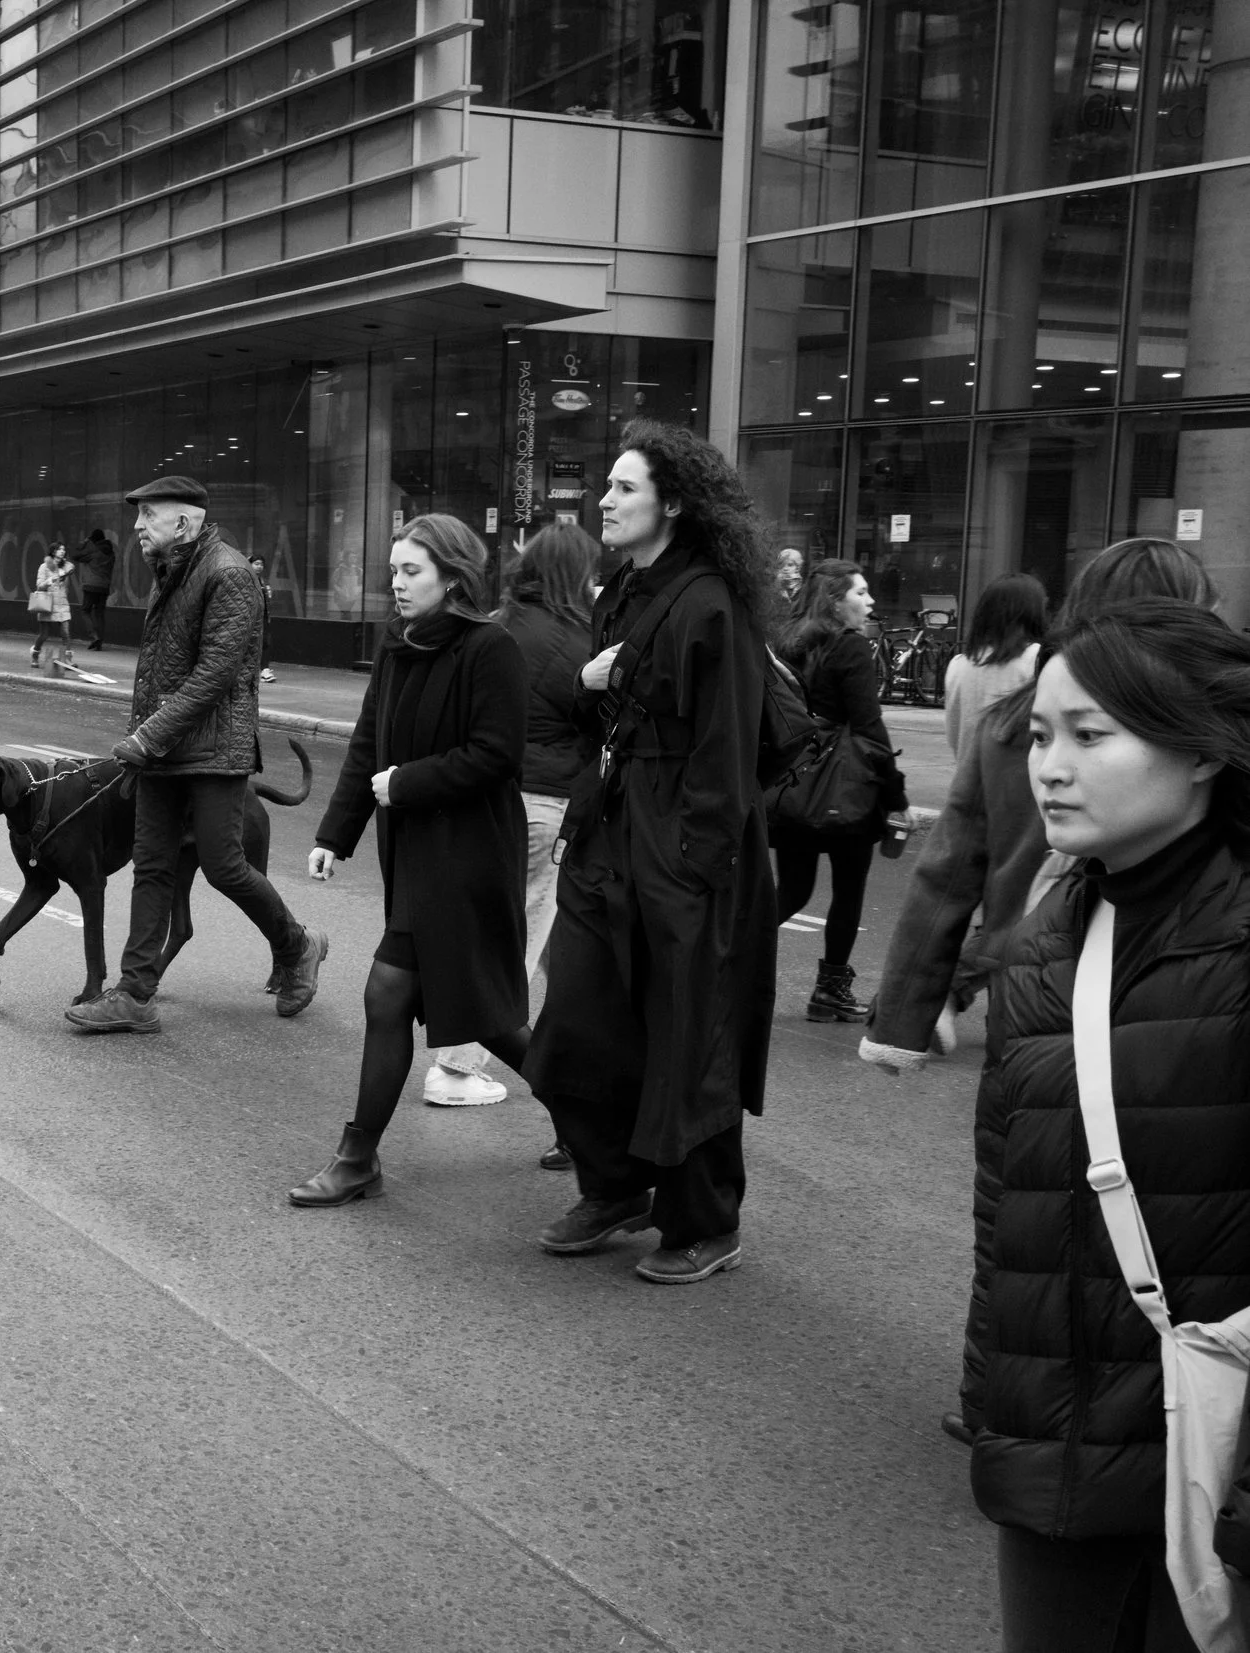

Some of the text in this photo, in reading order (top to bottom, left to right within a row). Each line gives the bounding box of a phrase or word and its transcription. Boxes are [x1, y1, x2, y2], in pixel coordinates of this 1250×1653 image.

[514, 360, 531, 523] PASSAGE CONCORDIA
[524, 391, 537, 524] THE CONCORDIA UNDERGROUND
[547, 488, 587, 499] SUBWAY
